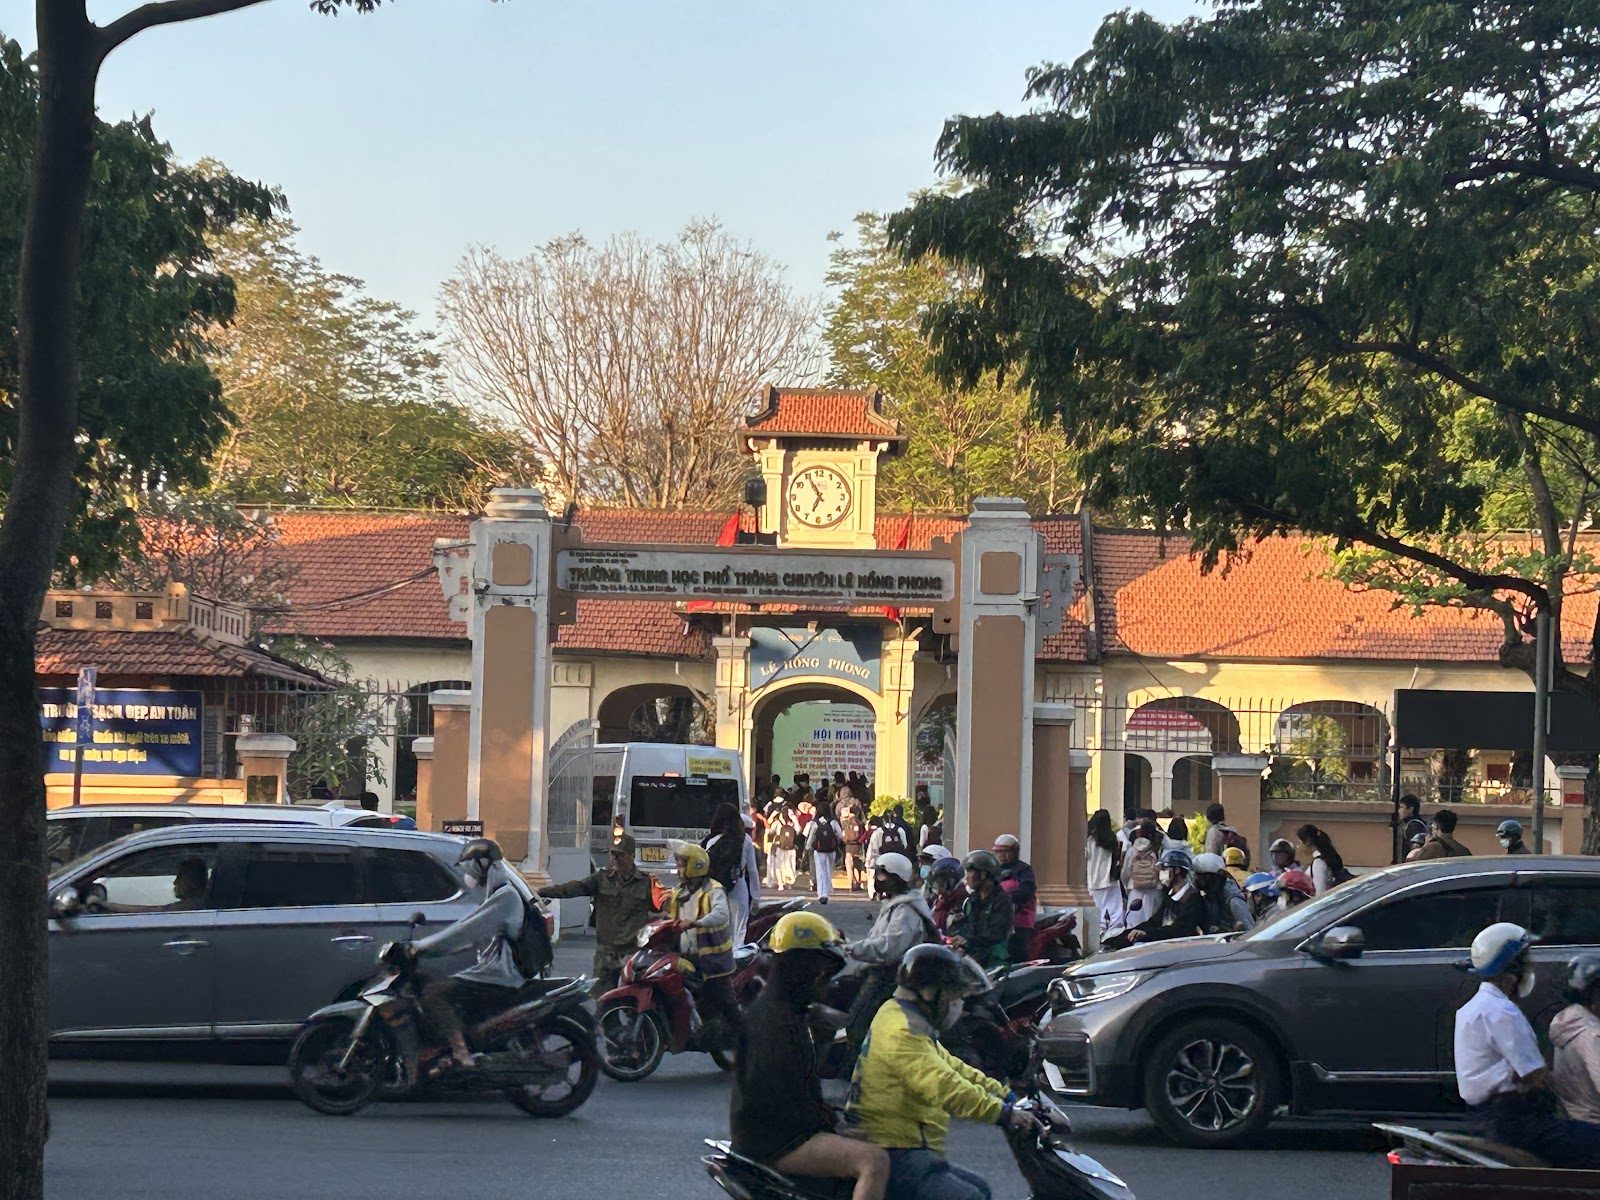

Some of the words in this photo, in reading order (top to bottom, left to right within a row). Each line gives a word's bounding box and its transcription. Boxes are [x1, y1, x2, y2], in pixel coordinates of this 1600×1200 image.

[796, 481, 804, 489] 10
[840, 493, 845, 501] 3
[816, 516, 821, 524] 6
[827, 513, 832, 521] 5
[569, 565, 622, 582] TRƯỜNG
[625, 569, 668, 583] TRUNG
[671, 569, 700, 586] HỌC
[703, 565, 730, 585] PHỔ
[733, 569, 778, 586] THÔNG
[782, 571, 834, 588] CHUYÊN
[837, 572, 854, 588] LÊ
[897, 576, 942, 590] PHONG
[828, 658, 871, 679] PHONG
[150, 706, 166, 720] AN
[167, 704, 197, 720] TOÀN
[813, 729, 831, 741] HỘI
[835, 730, 861, 742] NGHỊ
